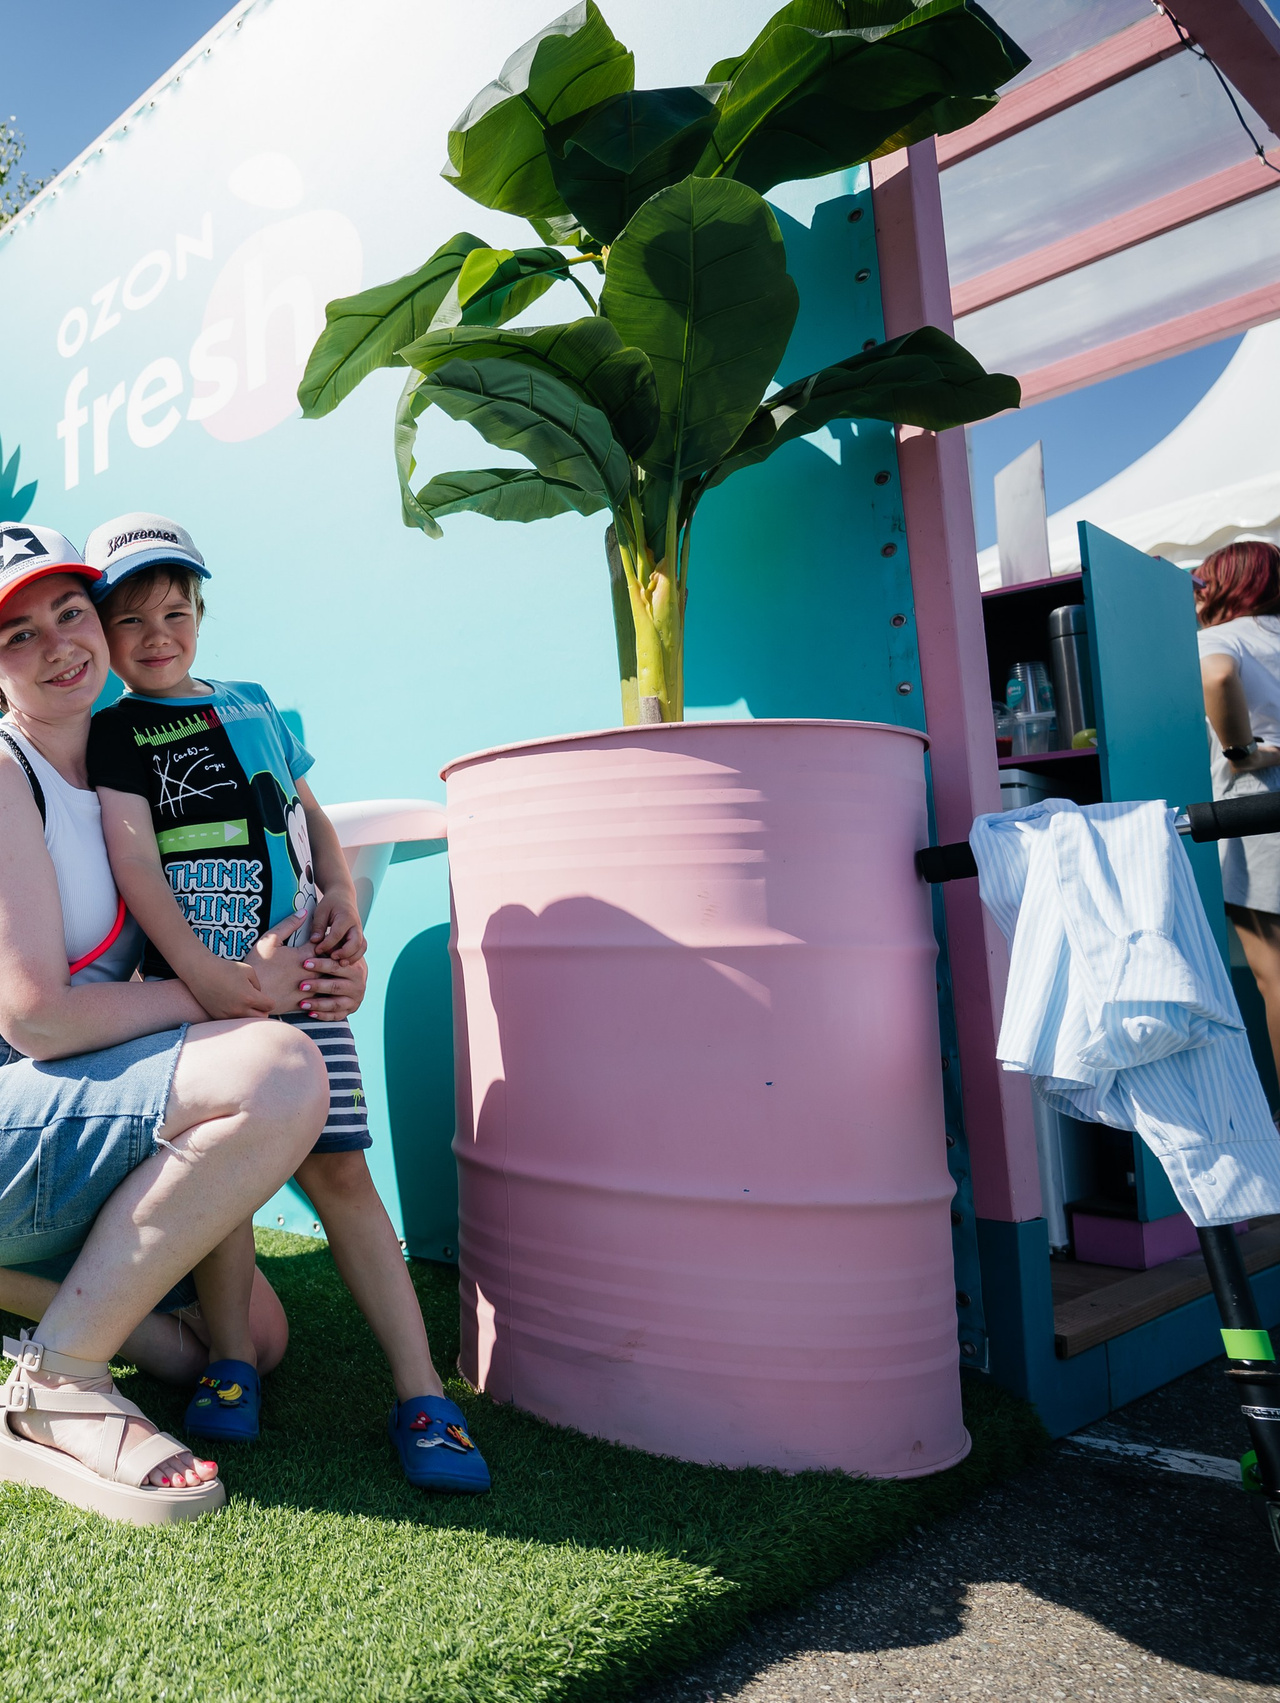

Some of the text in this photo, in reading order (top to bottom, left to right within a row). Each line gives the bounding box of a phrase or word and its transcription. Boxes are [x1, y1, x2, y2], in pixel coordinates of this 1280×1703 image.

[56, 210, 214, 359] OZON
[56, 253, 316, 491] fresh
[107, 530, 178, 557] SKATEBOARD
[165, 859, 263, 893] THINK
[174, 893, 262, 928] HINK
